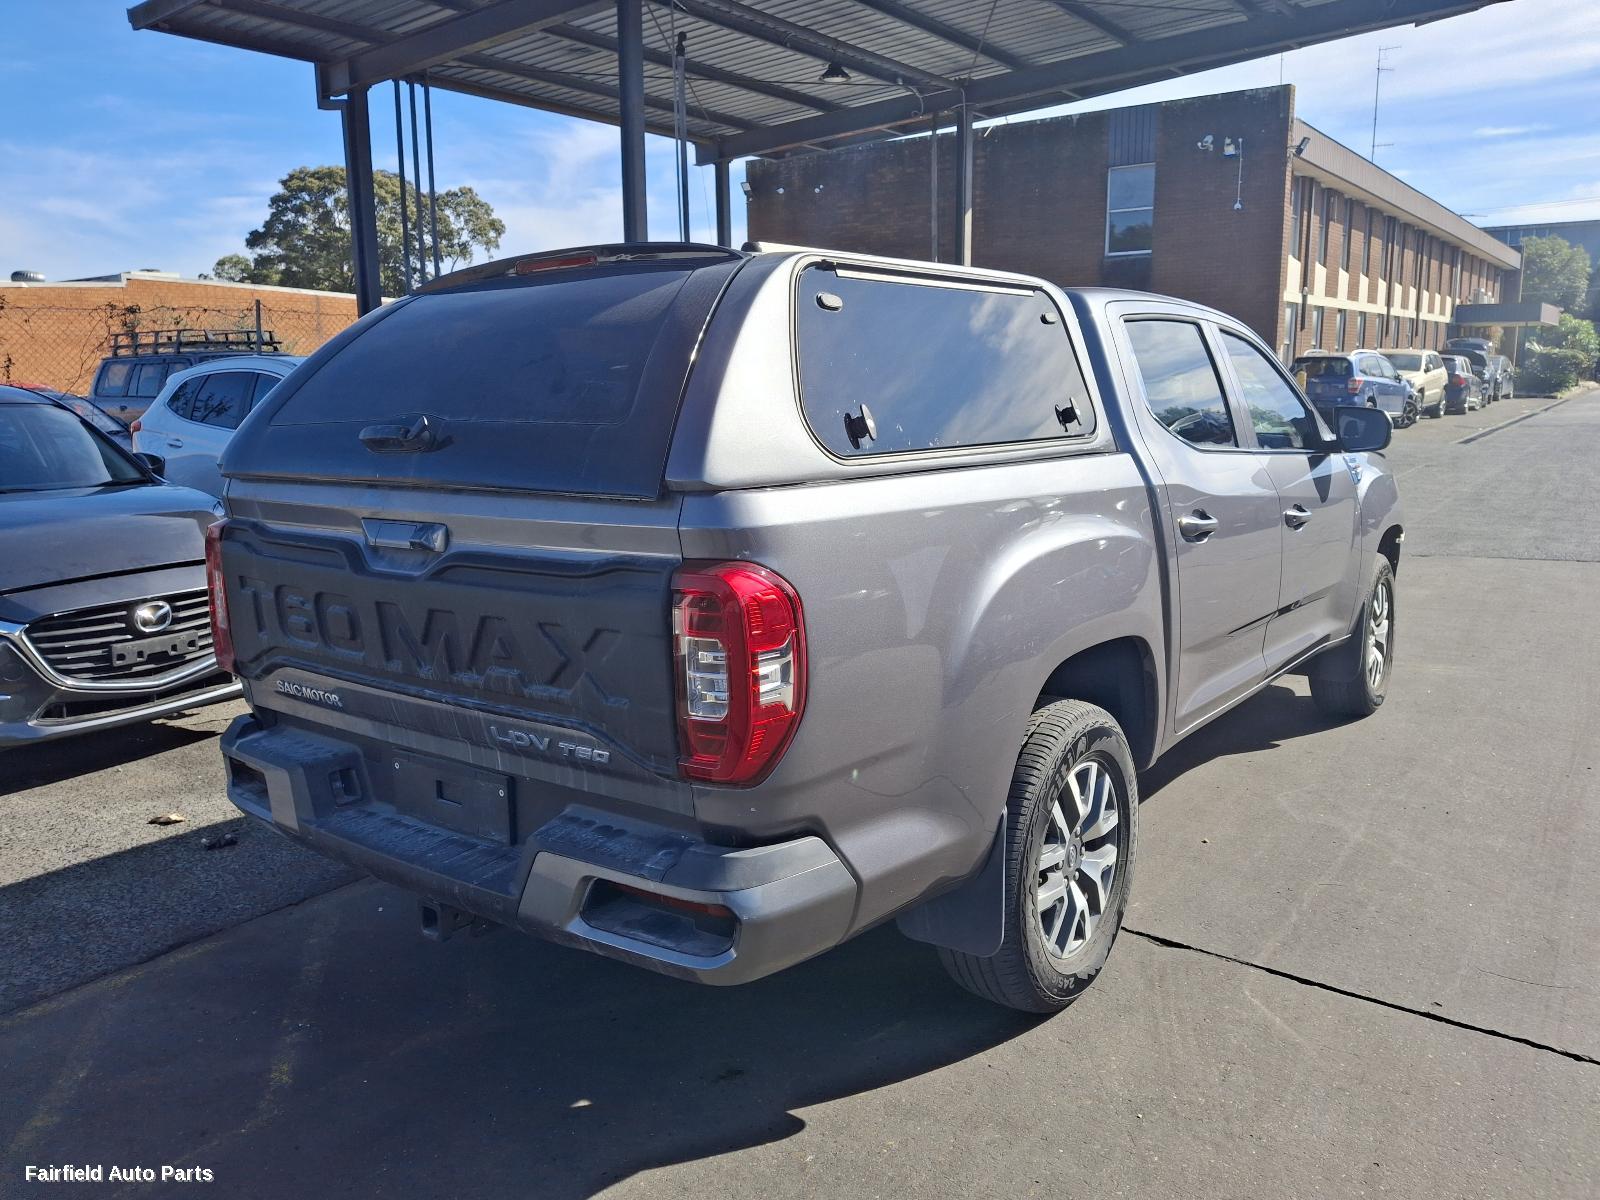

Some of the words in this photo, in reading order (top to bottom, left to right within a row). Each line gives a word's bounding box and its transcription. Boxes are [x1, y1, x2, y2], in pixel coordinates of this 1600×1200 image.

[375, 600, 631, 708] MAX
[276, 680, 302, 697] SAIC
[301, 686, 343, 708] MOTOR
[490, 726, 550, 751] LDV
[558, 742, 610, 764] T60
